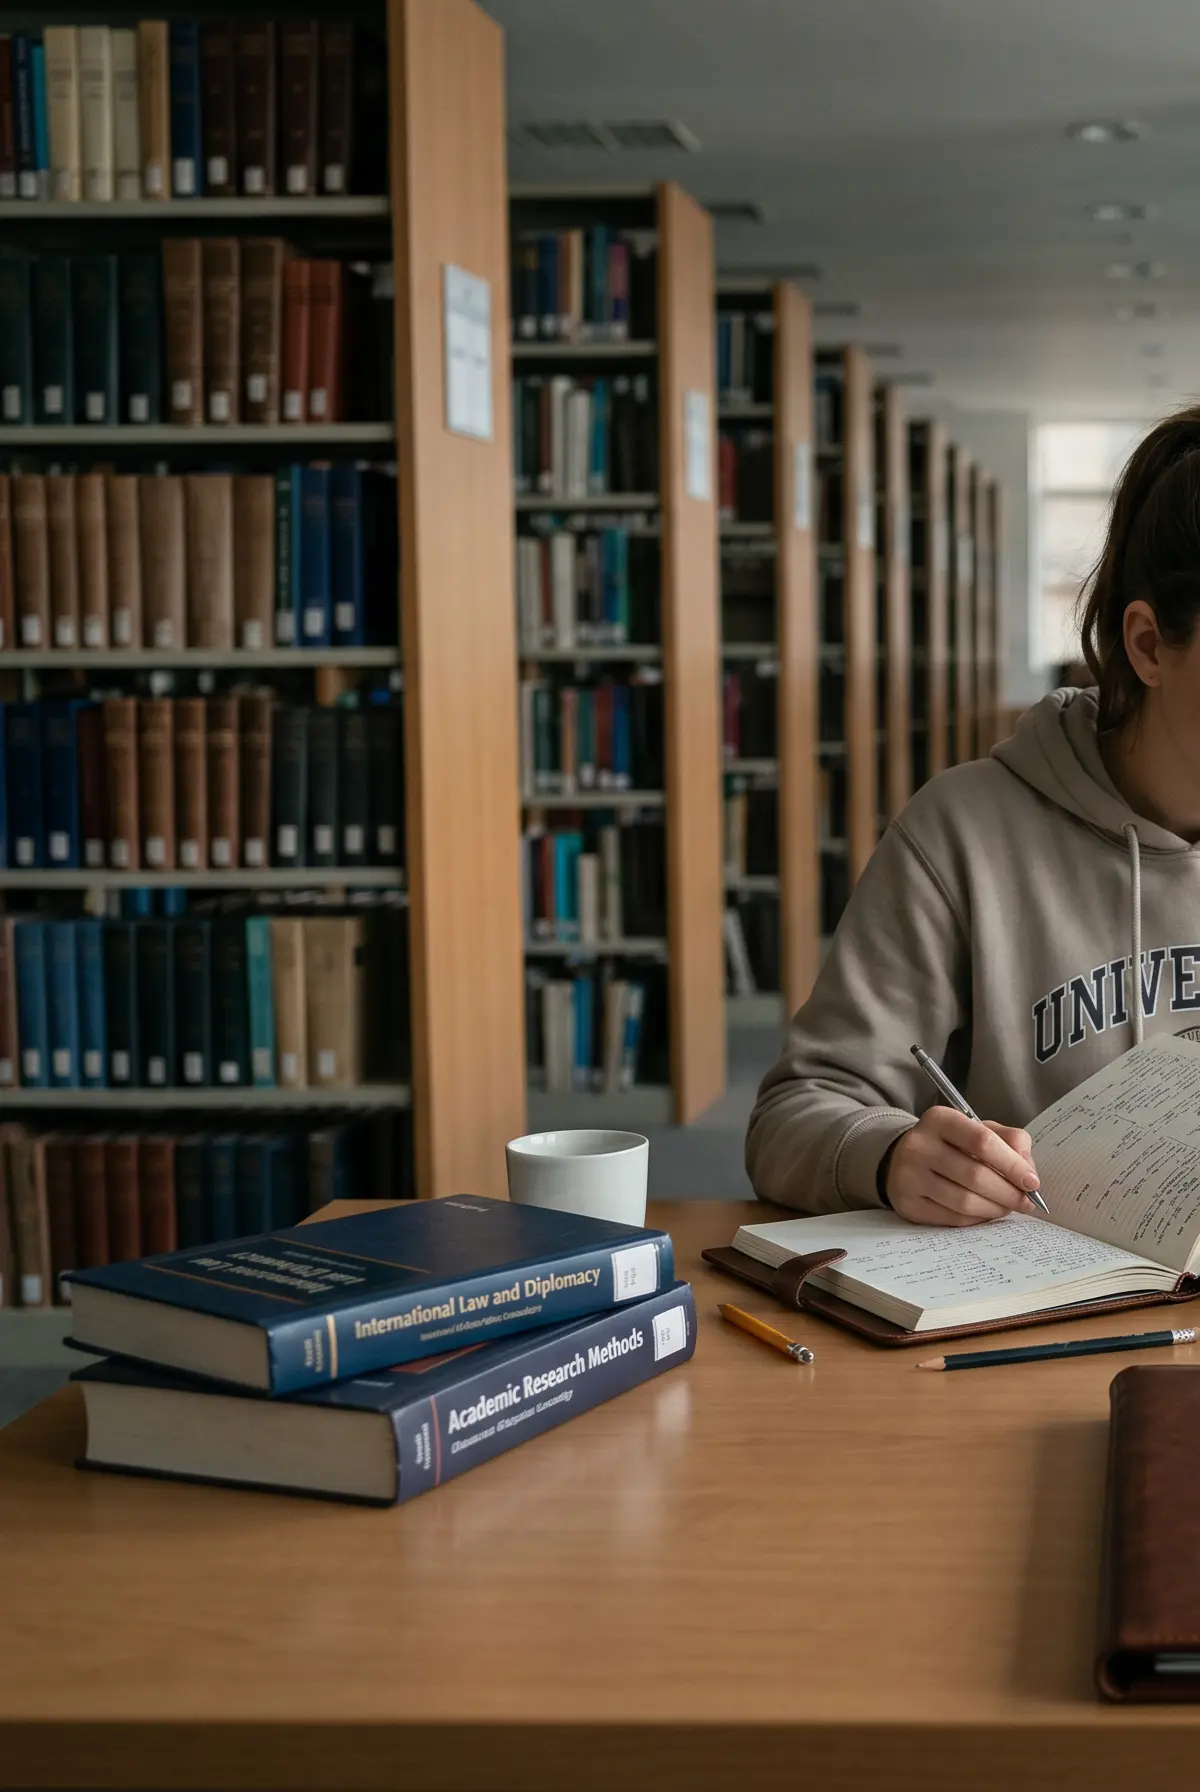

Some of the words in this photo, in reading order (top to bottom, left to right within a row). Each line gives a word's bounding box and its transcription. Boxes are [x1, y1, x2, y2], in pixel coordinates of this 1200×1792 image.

[355, 1298, 456, 1340] International
[458, 1295, 490, 1314] Law
[493, 1281, 521, 1306] and
[524, 1267, 601, 1299] Diplomacy
[448, 1383, 522, 1435] Academic
[522, 1352, 587, 1400] Research
[587, 1327, 645, 1370] Methods
